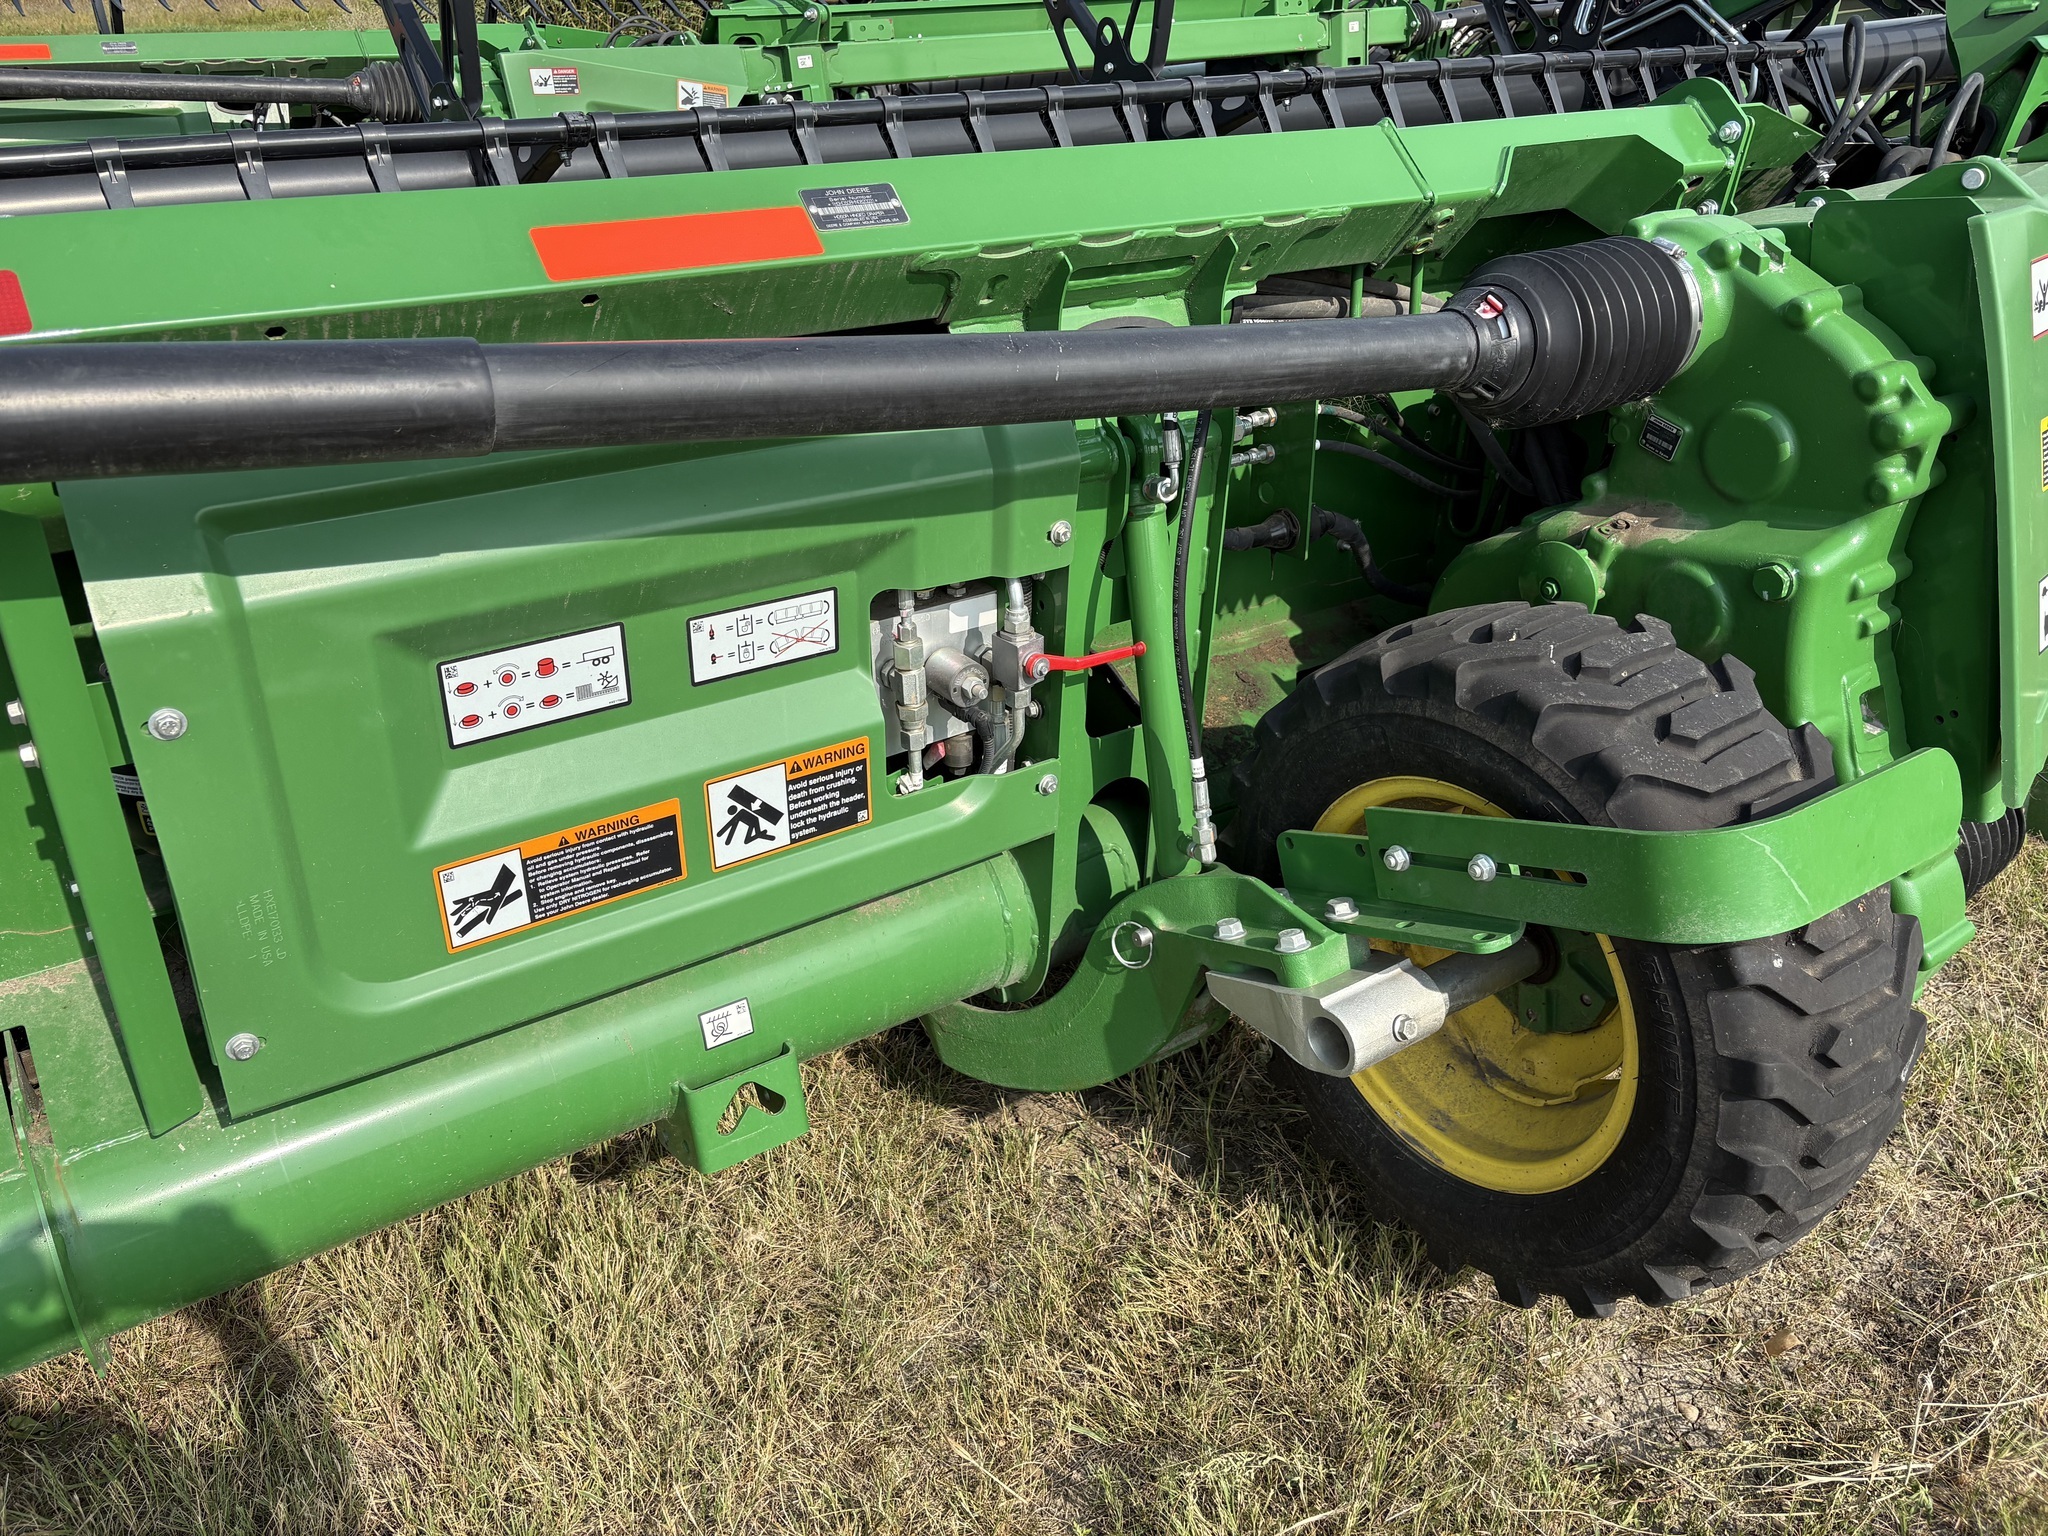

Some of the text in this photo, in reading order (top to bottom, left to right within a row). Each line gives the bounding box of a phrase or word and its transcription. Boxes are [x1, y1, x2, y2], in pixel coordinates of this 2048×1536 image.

[803, 743, 865, 769] WARNING
[788, 780, 807, 792] Avoid
[809, 774, 834, 785] serious
[835, 767, 854, 778] injury
[788, 777, 857, 801] death from crushing.
[789, 791, 840, 811] Before working
[790, 793, 865, 820] underneath the header,
[575, 815, 640, 841] WARNING
[790, 807, 849, 830] lock the hydraulic
[526, 856, 542, 865] Avoid
[543, 851, 564, 860] serious
[596, 835, 616, 844] contact
[629, 824, 654, 834] hydraulic
[791, 827, 818, 839] system.
[528, 831, 673, 877] Before removing hydraulic components, disassembling
[558, 854, 575, 862] under
[576, 846, 601, 858] pressure.
[536, 870, 562, 881] changing
[563, 859, 601, 873] accumulators:
[538, 878, 558, 887] Relieve
[559, 871, 579, 880] system
[580, 863, 605, 874] hydraulic
[606, 855, 634, 867] pressures.
[546, 880, 570, 891] Operator
[571, 873, 591, 883] Manual
[603, 865, 621, 873] Repair
[621, 858, 641, 867] Manual
[540, 880, 593, 899] system information.
[554, 892, 573, 901] engine
[574, 887, 585, 895] and
[585, 882, 606, 891] remove
[559, 898, 571, 906] DRY
[572, 888, 601, 901] NITROGEN
[611, 877, 639, 889] recharging
[640, 867, 673, 880] accumulator.
[560, 904, 574, 912] John
[575, 899, 591, 907] Deere
[591, 893, 609, 901] dealer.
[249, 894, 273, 966] MADE IN USA
[1639, 955, 1682, 1115] CHIEF
